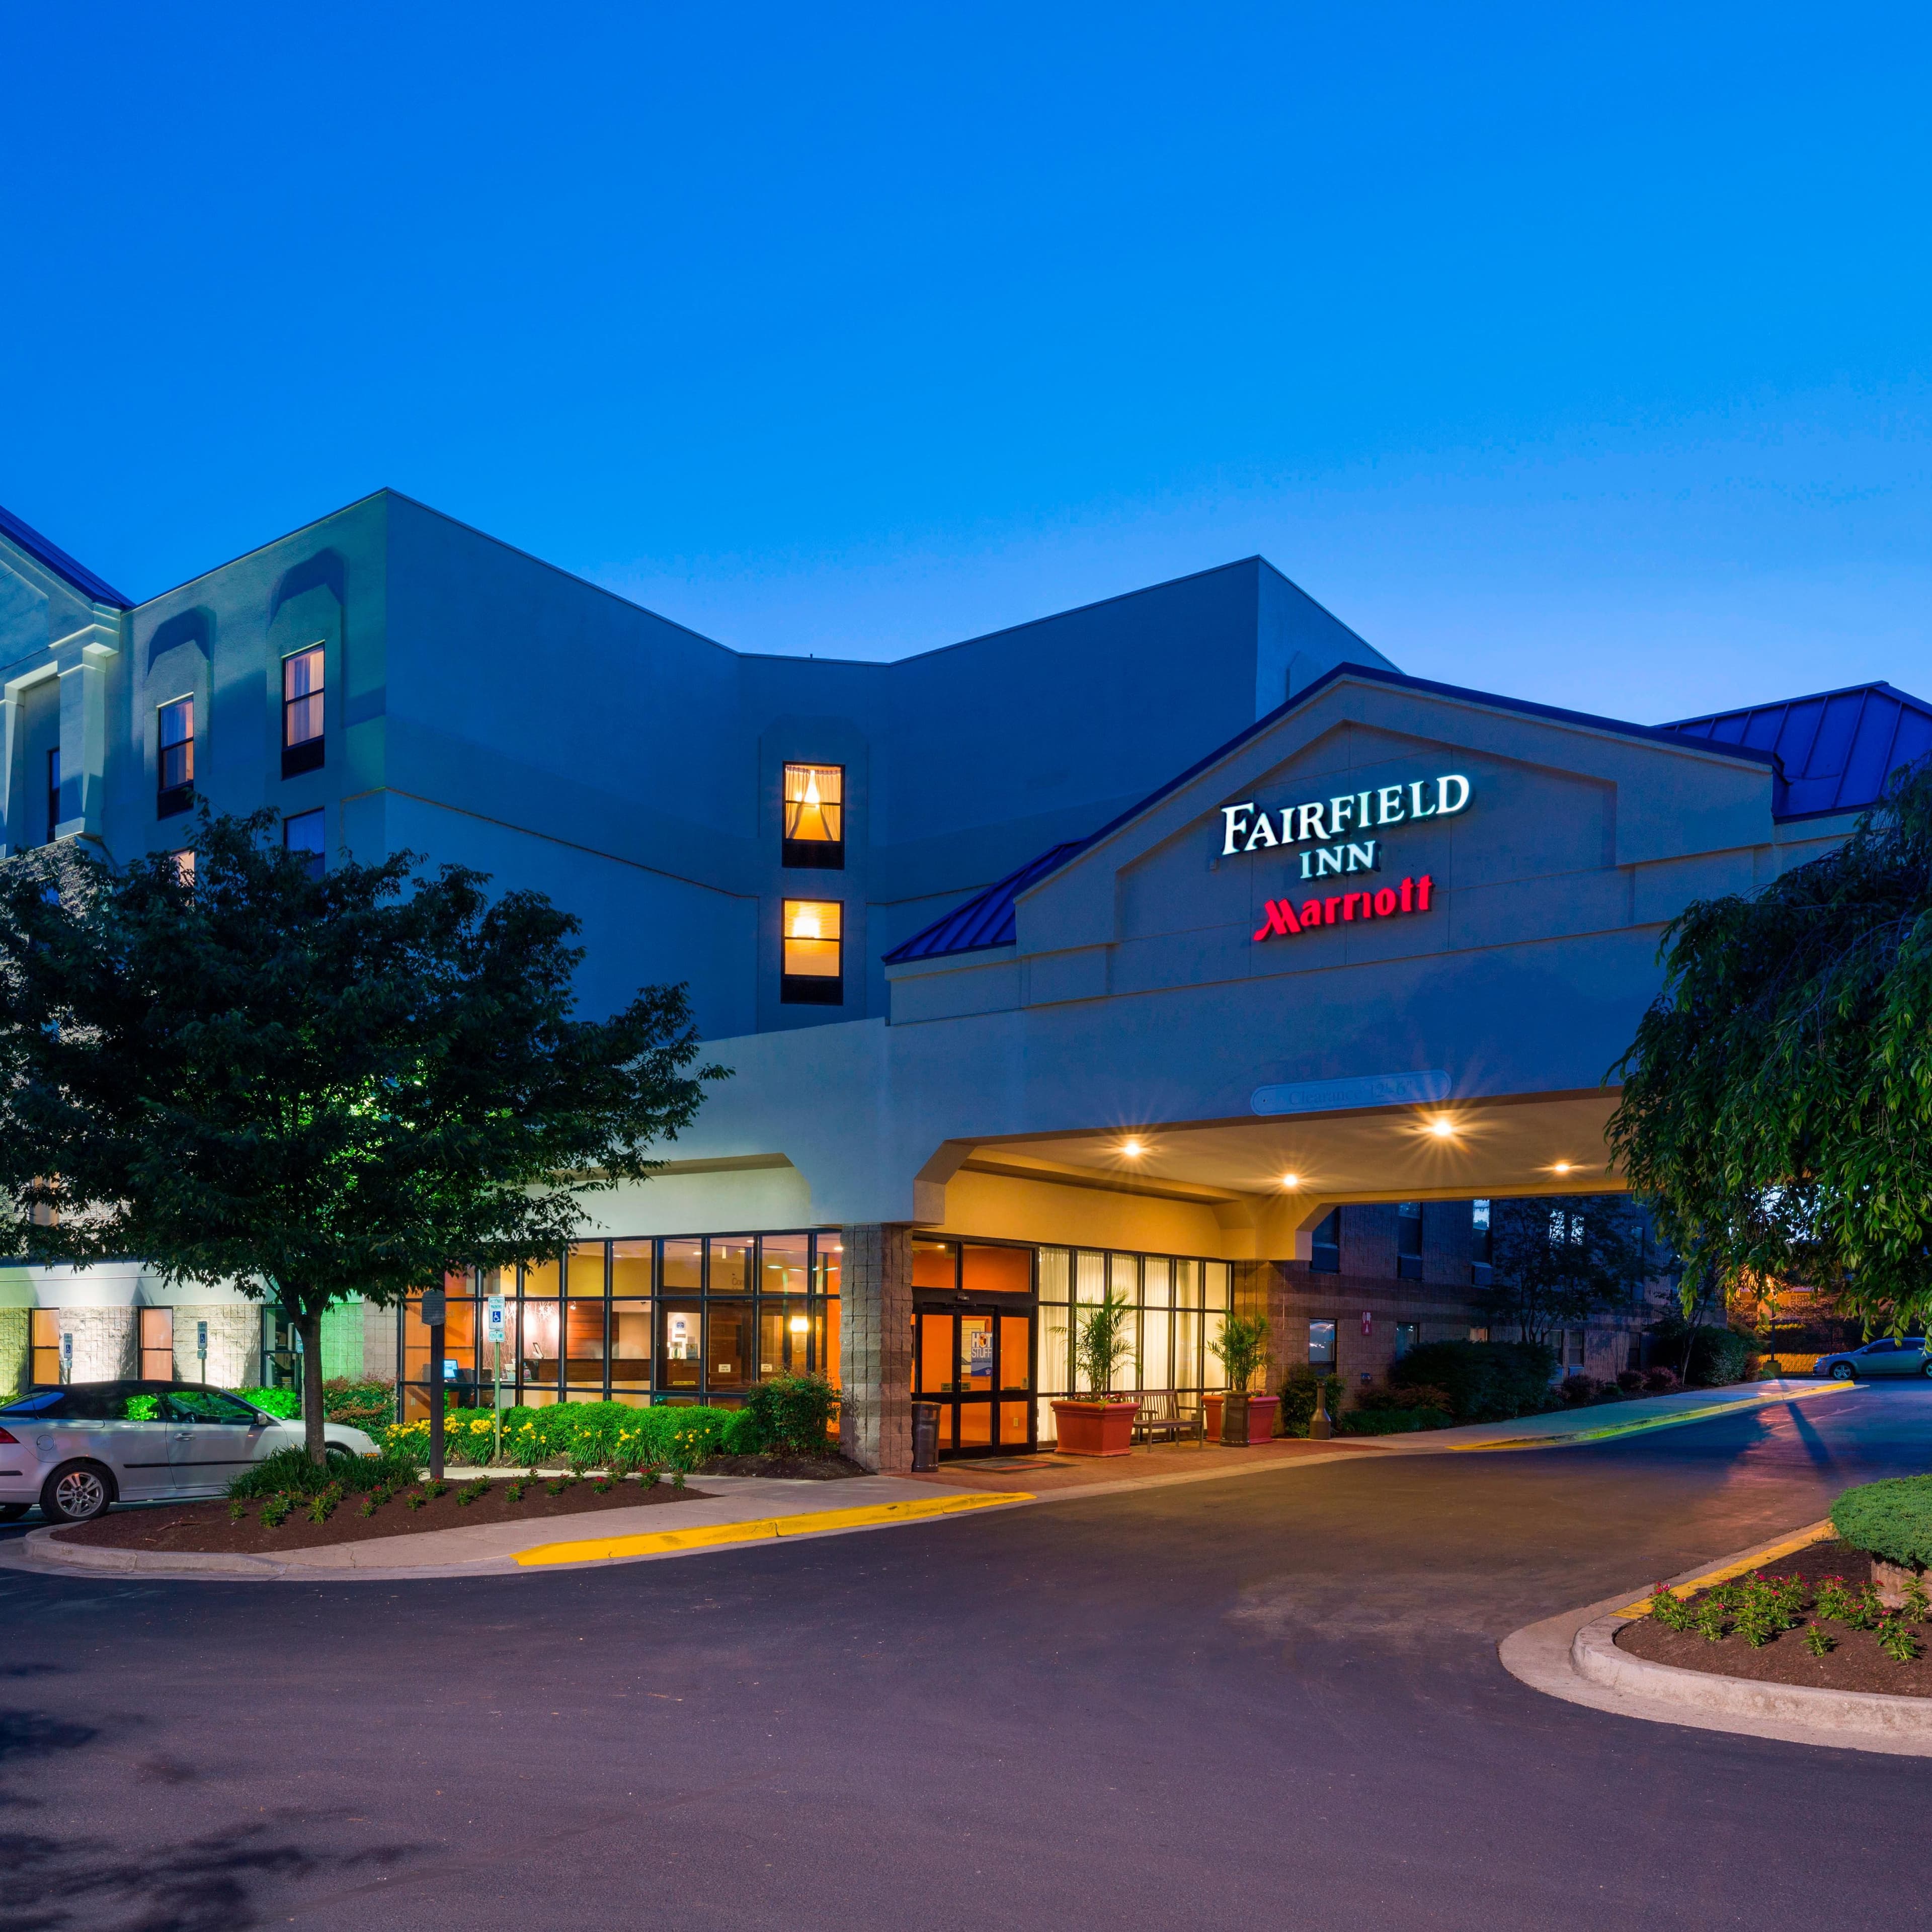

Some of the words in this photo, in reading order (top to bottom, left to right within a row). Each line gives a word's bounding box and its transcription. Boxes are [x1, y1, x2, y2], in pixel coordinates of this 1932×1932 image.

[1221, 774, 1470, 855] FAIRFIELD
[1299, 840, 1376, 879] INN
[1253, 874, 1433, 941] Marriott
[1289, 1087, 1362, 1105] Clearance
[972, 1332, 993, 1348] HOT
[972, 1348, 992, 1358] STUFF
